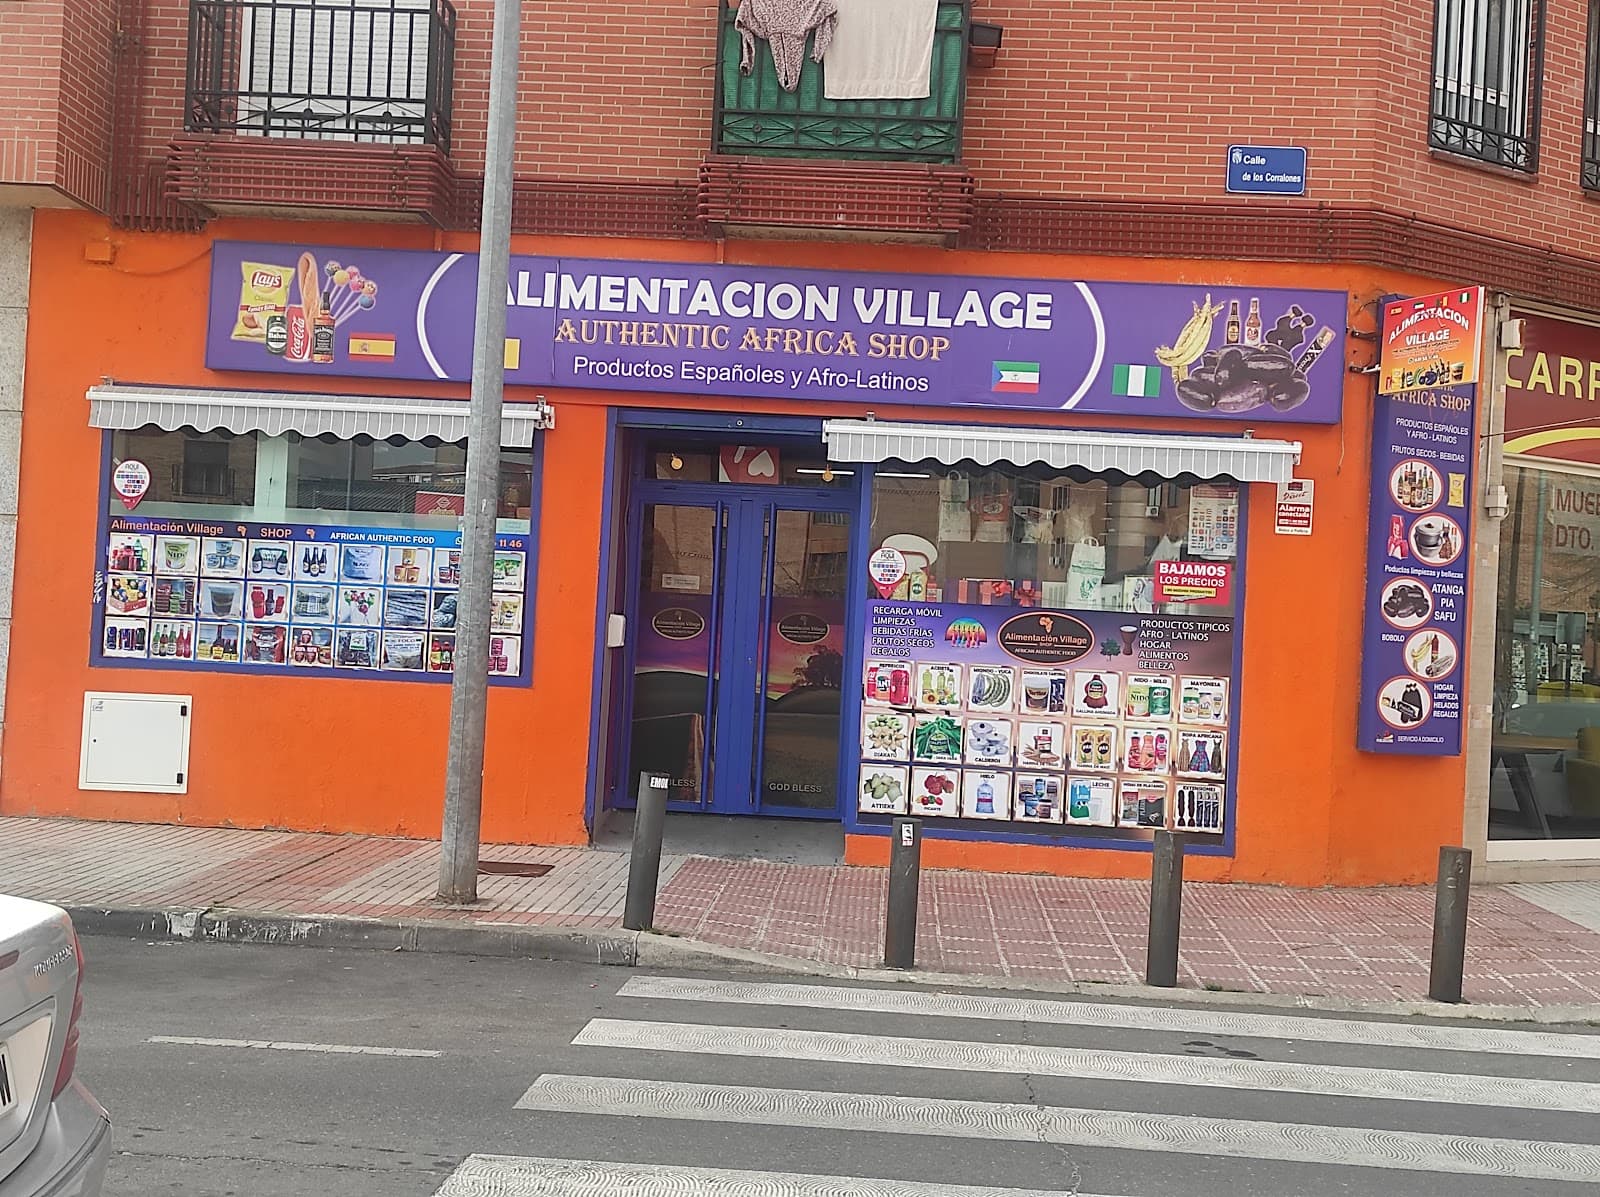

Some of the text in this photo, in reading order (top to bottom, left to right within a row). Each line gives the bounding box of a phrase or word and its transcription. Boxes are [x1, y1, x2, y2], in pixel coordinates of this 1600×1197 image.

[1243, 155, 1267, 165] Calle
[1242, 172, 1302, 183] de los Corralones
[853, 287, 1053, 330] VILLAGE
[1388, 306, 1469, 344] ALIMENTACION
[555, 318, 950, 361] AUTHENTIC AFRICA SHOP
[1406, 329, 1450, 346] VILLAGE
[574, 356, 929, 392] Productos Españoles y Afro-Latinos
[1440, 393, 1471, 412] SHOP
[1395, 417, 1469, 436] PRODUCTOS ESPAÑOLES
[1407, 429, 1411, 437] Y
[1412, 430, 1428, 440] AFRO
[1432, 433, 1457, 444] LATINOS
[1391, 445, 1415, 456] FRUTOS
[1440, 451, 1465, 462] BEBIDAS
[111, 520, 435, 544] Alimentación Village SHOP AFRICAN AUTHENTIC FOOD
[1555, 524, 1594, 550] DTO.
[509, 539, 522, 548] 46
[1160, 563, 1226, 577] BAJAMOS
[1160, 576, 1225, 587] LOS PRECIOS
[1432, 583, 1464, 595] ATANGA
[1441, 598, 1454, 608] PIA
[874, 607, 943, 618] RECARGA MÓVIL
[1434, 611, 1457, 622] SAFU
[873, 617, 916, 626] LIMPIEZAS
[1140, 620, 1230, 632] PRODUCTOS TIPICOS
[872, 628, 933, 637] BEBIDAS FRÍAS
[1139, 631, 1164, 639] AFRO
[1171, 632, 1209, 641] LATINOS
[1381, 633, 1405, 642] BOBOLO
[872, 637, 934, 648] FRUTOS SECOS
[1005, 632, 1087, 645] Alimentación Village
[1139, 641, 1171, 650] HOGAR
[871, 648, 910, 657] REGALOS
[1139, 651, 1189, 661] ALIMENTOS
[1138, 661, 1175, 671] BELLEZA
[1434, 683, 1454, 692] HOGAR
[1434, 692, 1459, 701] LIMPIEZA
[1433, 701, 1459, 710] HELADOS
[1433, 709, 1459, 718] REGALOS
[669, 779, 696, 788] LESS
[769, 782, 822, 793] GOD BLESS
